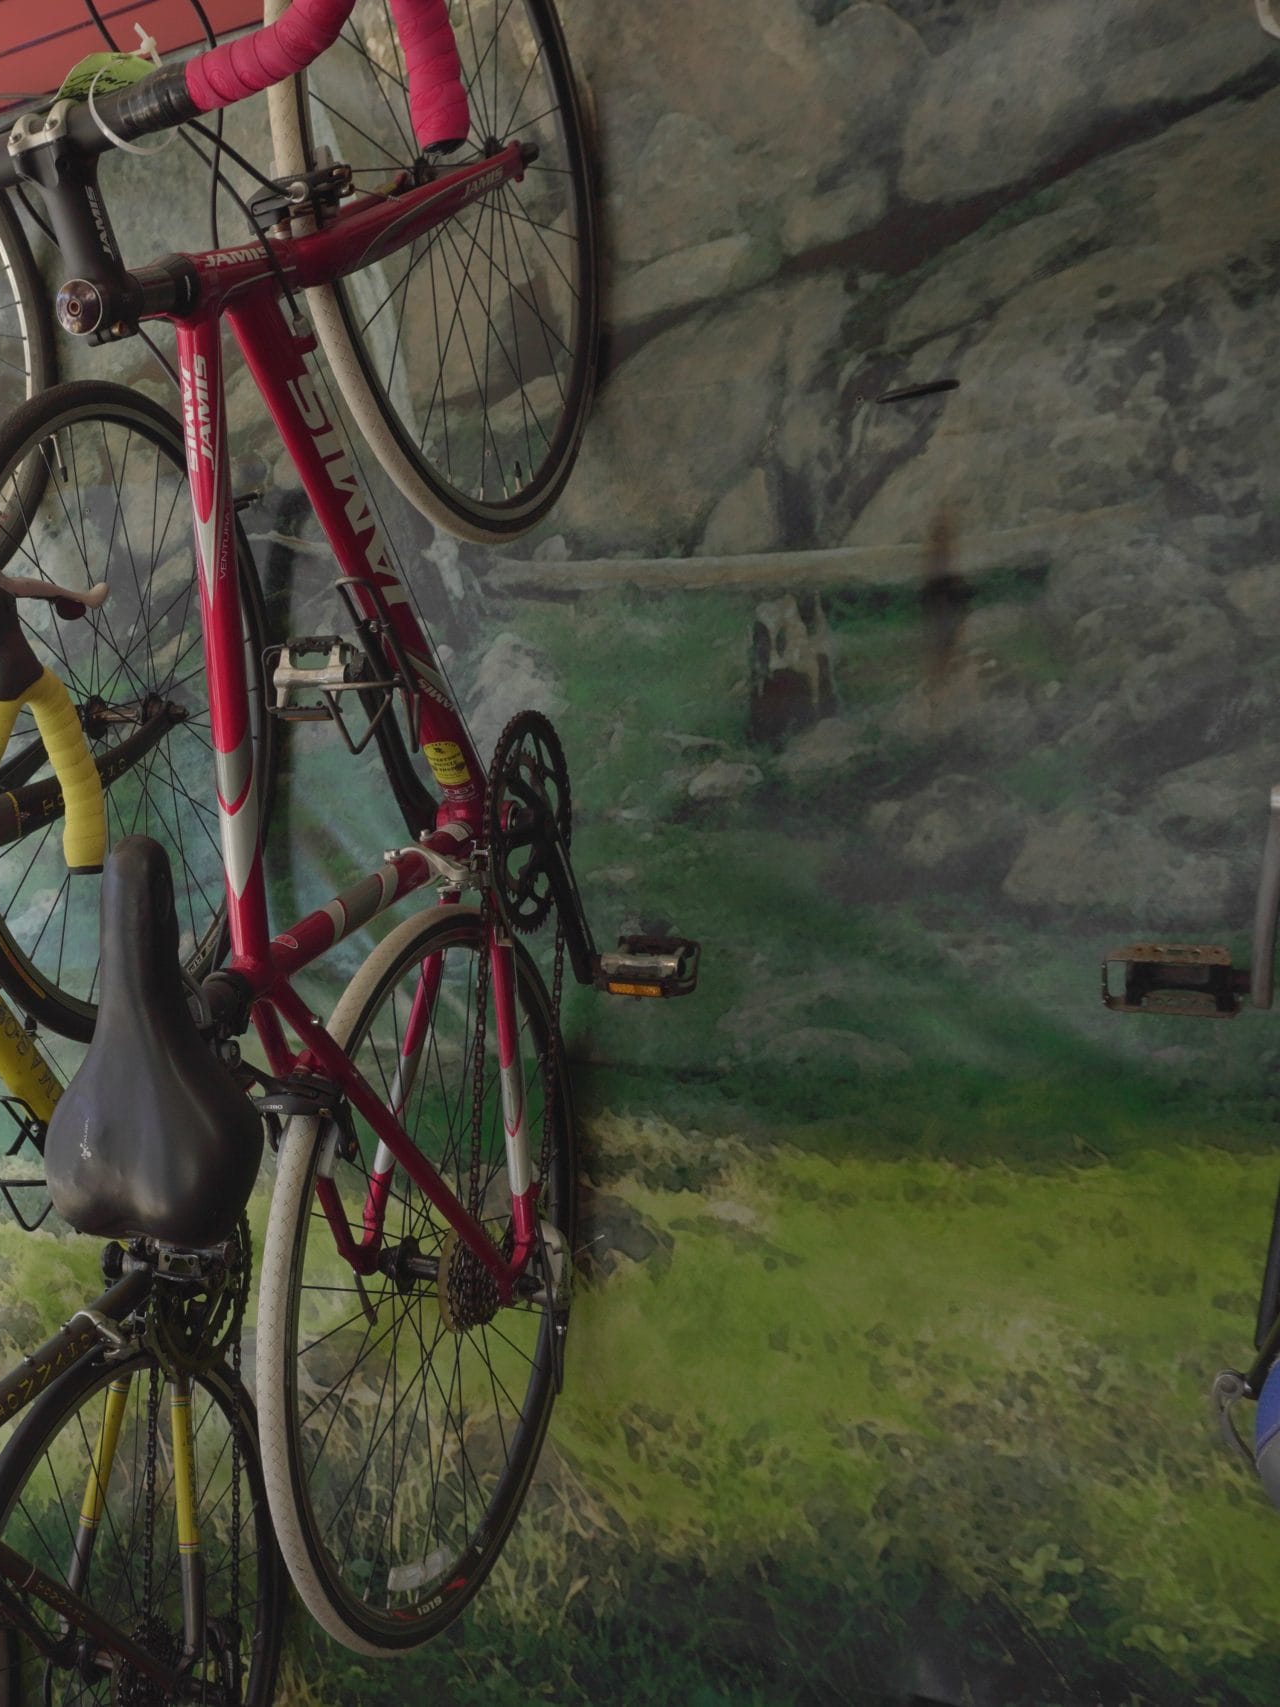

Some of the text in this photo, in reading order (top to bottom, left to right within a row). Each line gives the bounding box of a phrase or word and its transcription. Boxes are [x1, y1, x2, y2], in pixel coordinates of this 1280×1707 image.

[84, 184, 116, 262] JAMIS
[462, 165, 504, 200] JAMIS
[180, 356, 198, 473] JAMIS
[192, 352, 215, 472] JAMIS
[287, 375, 408, 605] JAMIS
[218, 512, 233, 580] VENTURA
